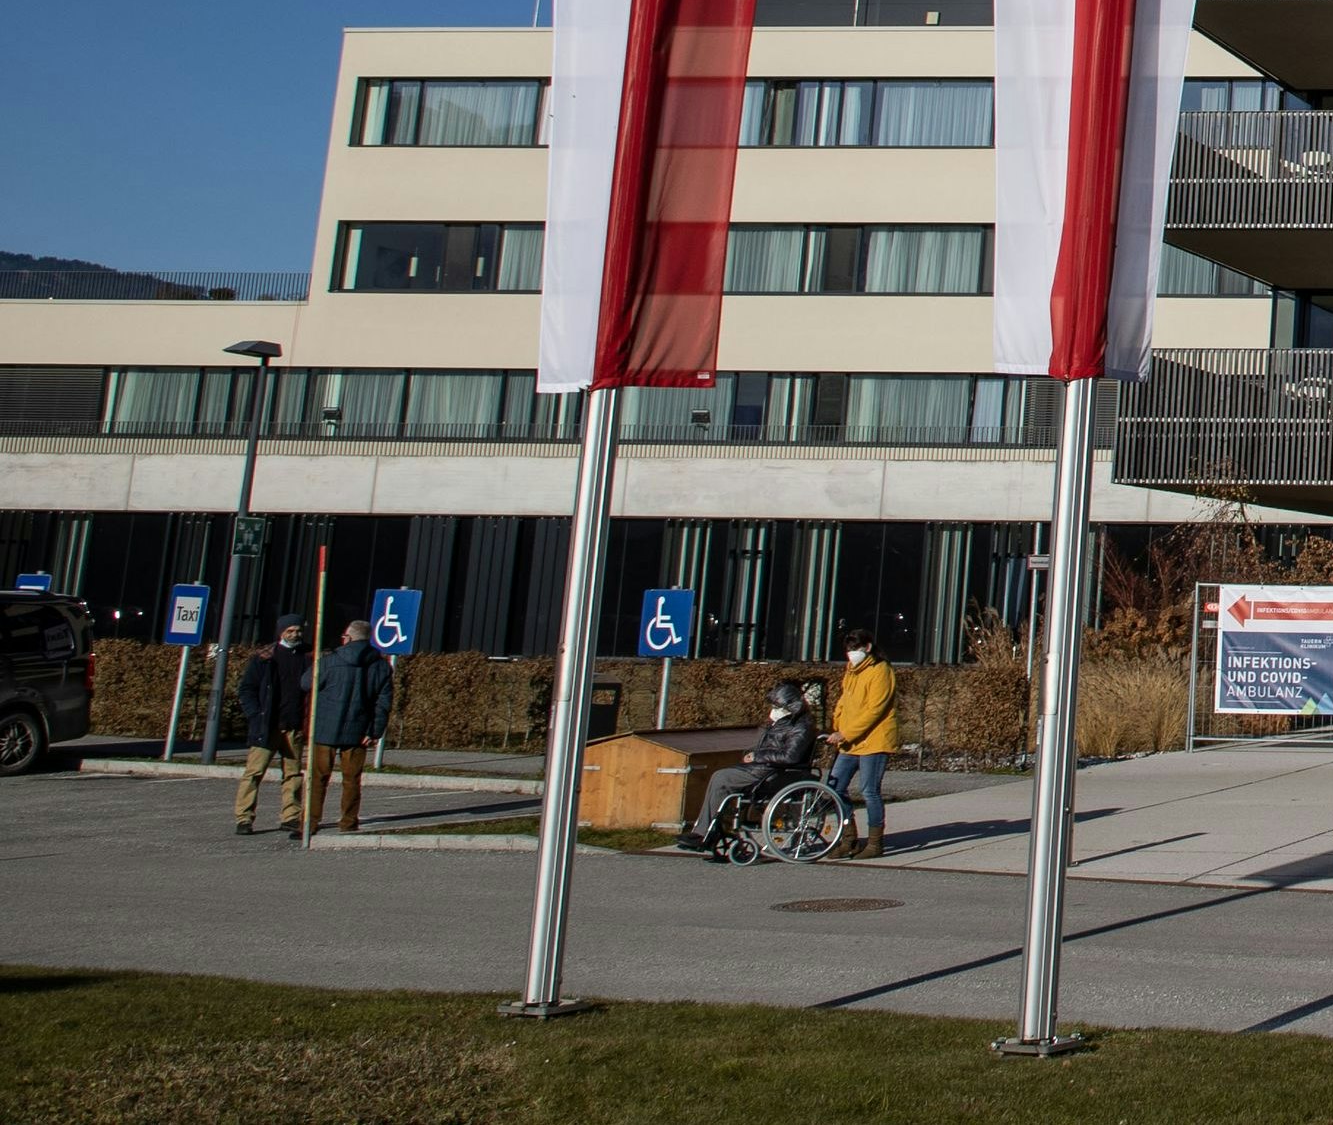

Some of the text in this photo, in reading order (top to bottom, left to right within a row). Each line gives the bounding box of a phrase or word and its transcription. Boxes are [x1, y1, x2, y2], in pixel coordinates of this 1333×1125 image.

[176, 606, 200, 622] Taxi
[1227, 656, 1318, 669] INFEKTIONS-
[1227, 671, 1308, 684] UND COVID-
[1226, 685, 1304, 699] AMBULANZ
